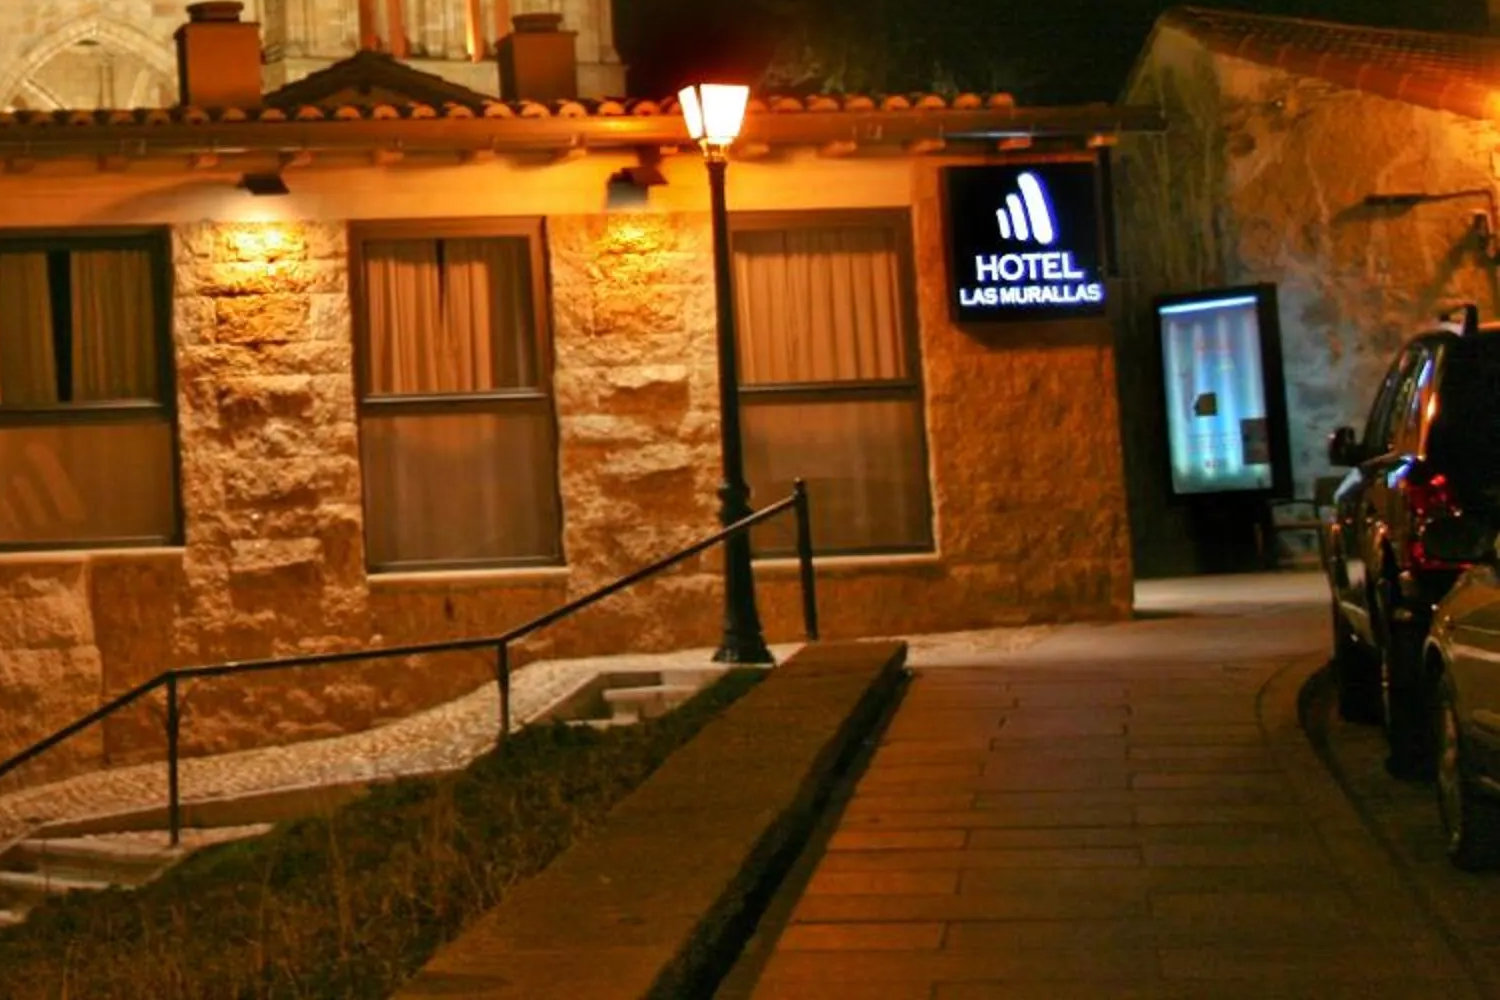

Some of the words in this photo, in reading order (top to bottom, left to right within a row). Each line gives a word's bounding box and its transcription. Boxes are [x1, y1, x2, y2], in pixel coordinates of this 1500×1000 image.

[975, 252, 1083, 281] HOTEL
[959, 287, 997, 306] LAS
[1000, 283, 1102, 304] MURALLAS
